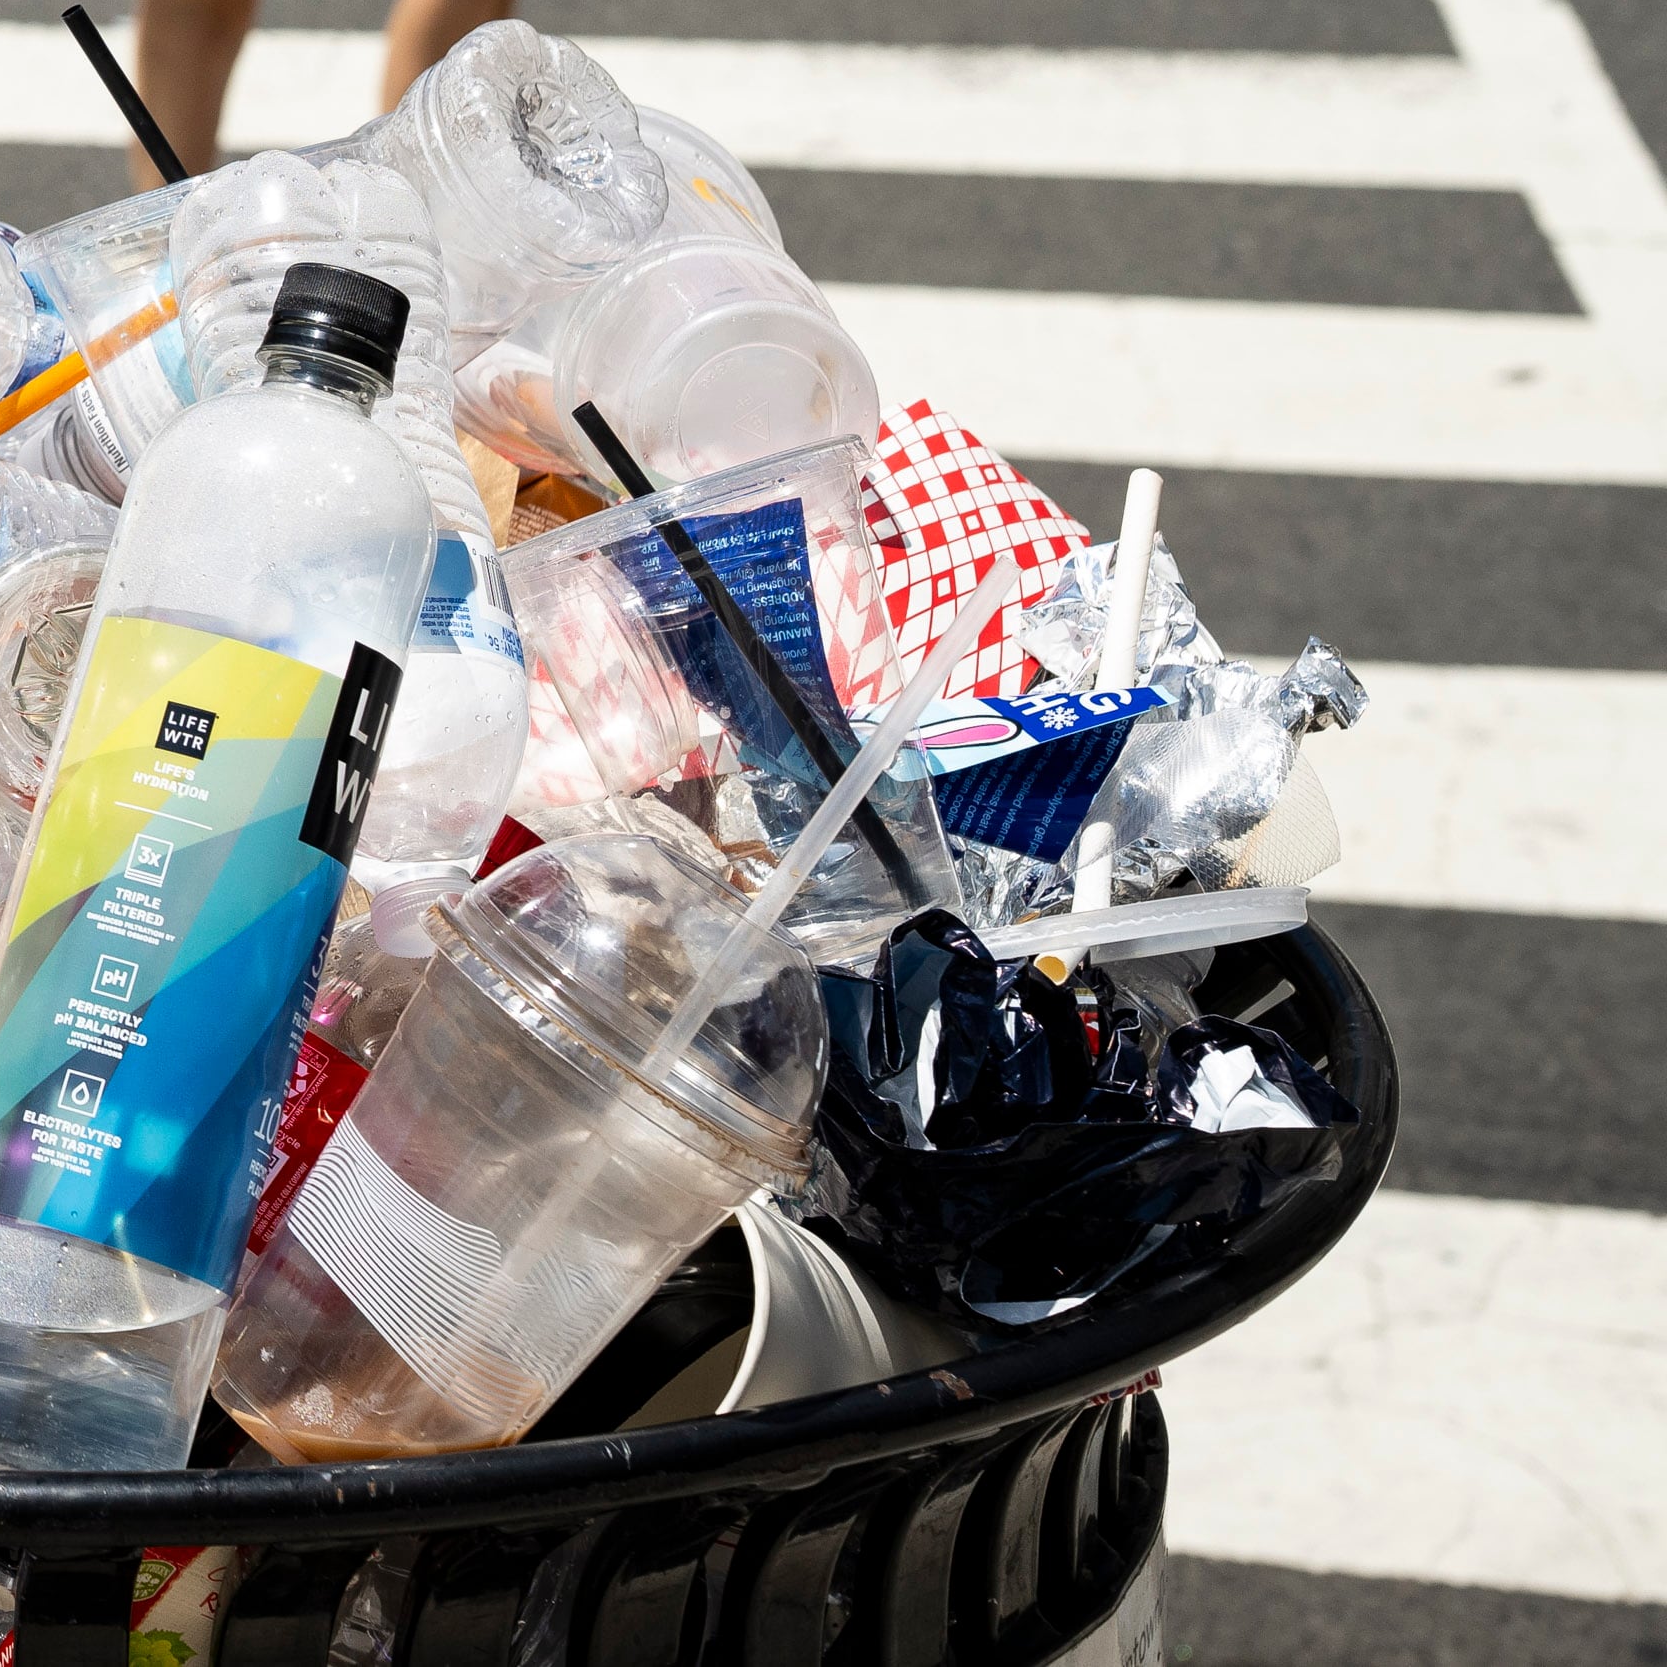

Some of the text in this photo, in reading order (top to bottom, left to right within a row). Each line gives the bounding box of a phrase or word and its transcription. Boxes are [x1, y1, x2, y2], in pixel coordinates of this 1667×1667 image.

[79, 389, 128, 467] Nutrition Facts
[755, 559, 800, 576] Nanyang
[746, 575, 802, 593] Longsheng
[751, 590, 805, 607] ADDRESS:
[758, 610, 808, 627] Nanyang
[783, 647, 807, 659] avoid
[168, 710, 209, 733] LIFE
[162, 728, 204, 751] WTR
[153, 760, 195, 781] LIFE'S
[1060, 732, 1098, 787] hydrophilic
[132, 771, 209, 801] HYDRATION
[936, 782, 953, 803] and
[971, 775, 993, 805] water
[988, 772, 1012, 807] excess
[1010, 770, 1038, 808] applied
[978, 806, 995, 829] heat
[1038, 785, 1067, 827] polymer
[998, 807, 1018, 835] when
[1030, 826, 1047, 843] gel
[136, 845, 162, 867] 3x
[113, 887, 162, 910] TRIPLE
[103, 900, 164, 926] FILTERED
[101, 968, 128, 988] pH
[68, 998, 143, 1028] PERFECTLY
[54, 1012, 148, 1047] pH BALANCED
[23, 1109, 122, 1149] ELECTROLYTES
[31, 1128, 103, 1159] FOR TASTE
